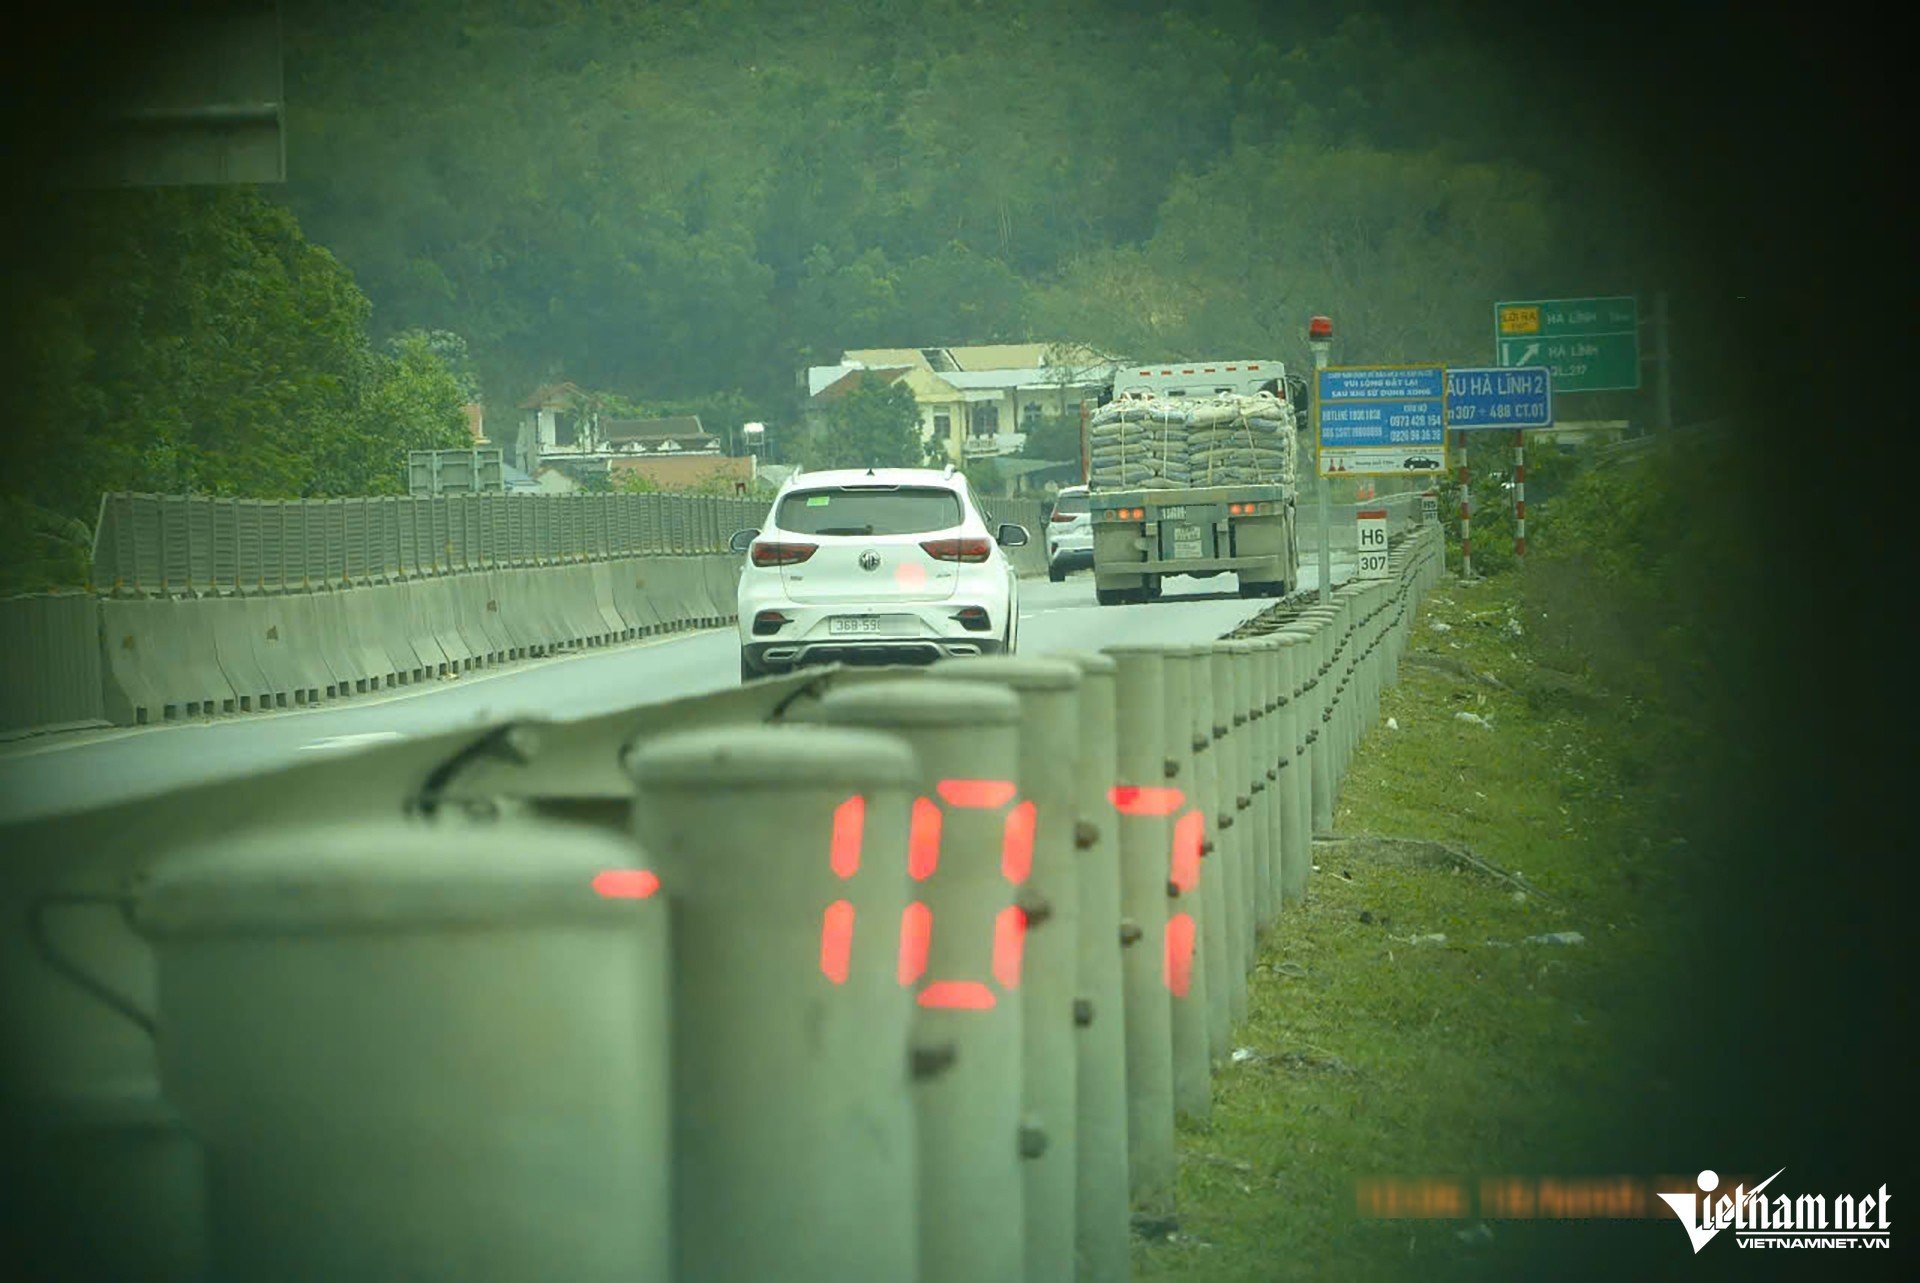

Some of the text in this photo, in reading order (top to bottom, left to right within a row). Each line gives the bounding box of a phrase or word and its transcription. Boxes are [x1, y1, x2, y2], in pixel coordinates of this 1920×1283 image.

[1497, 373, 1531, 395] LĨNH
[1534, 376, 1543, 394] 2
[1361, 529, 1384, 546] H6
[1361, 556, 1386, 571] 307
